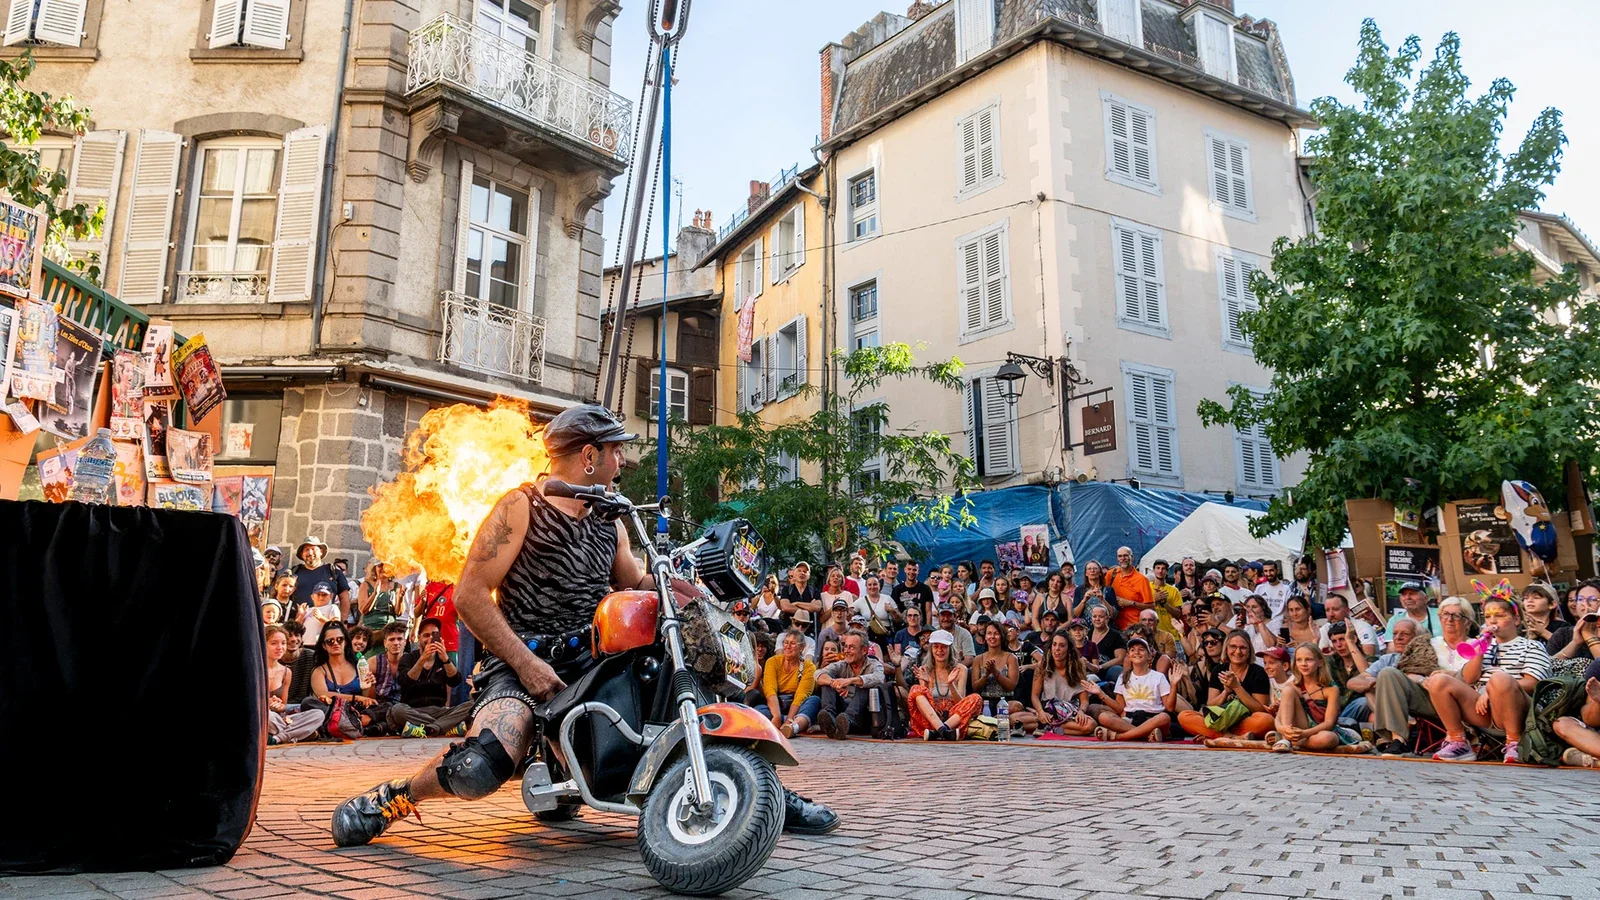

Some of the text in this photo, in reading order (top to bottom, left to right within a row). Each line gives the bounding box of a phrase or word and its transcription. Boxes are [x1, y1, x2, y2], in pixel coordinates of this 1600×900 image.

[1084, 424, 1112, 437] BERNARD
[158, 489, 196, 503] BISOUS
[1389, 549, 1406, 557] DANSE
[1389, 556, 1413, 564] MACHINE
[1389, 563, 1411, 571] VOLUME
[434, 605, 446, 617] 10
